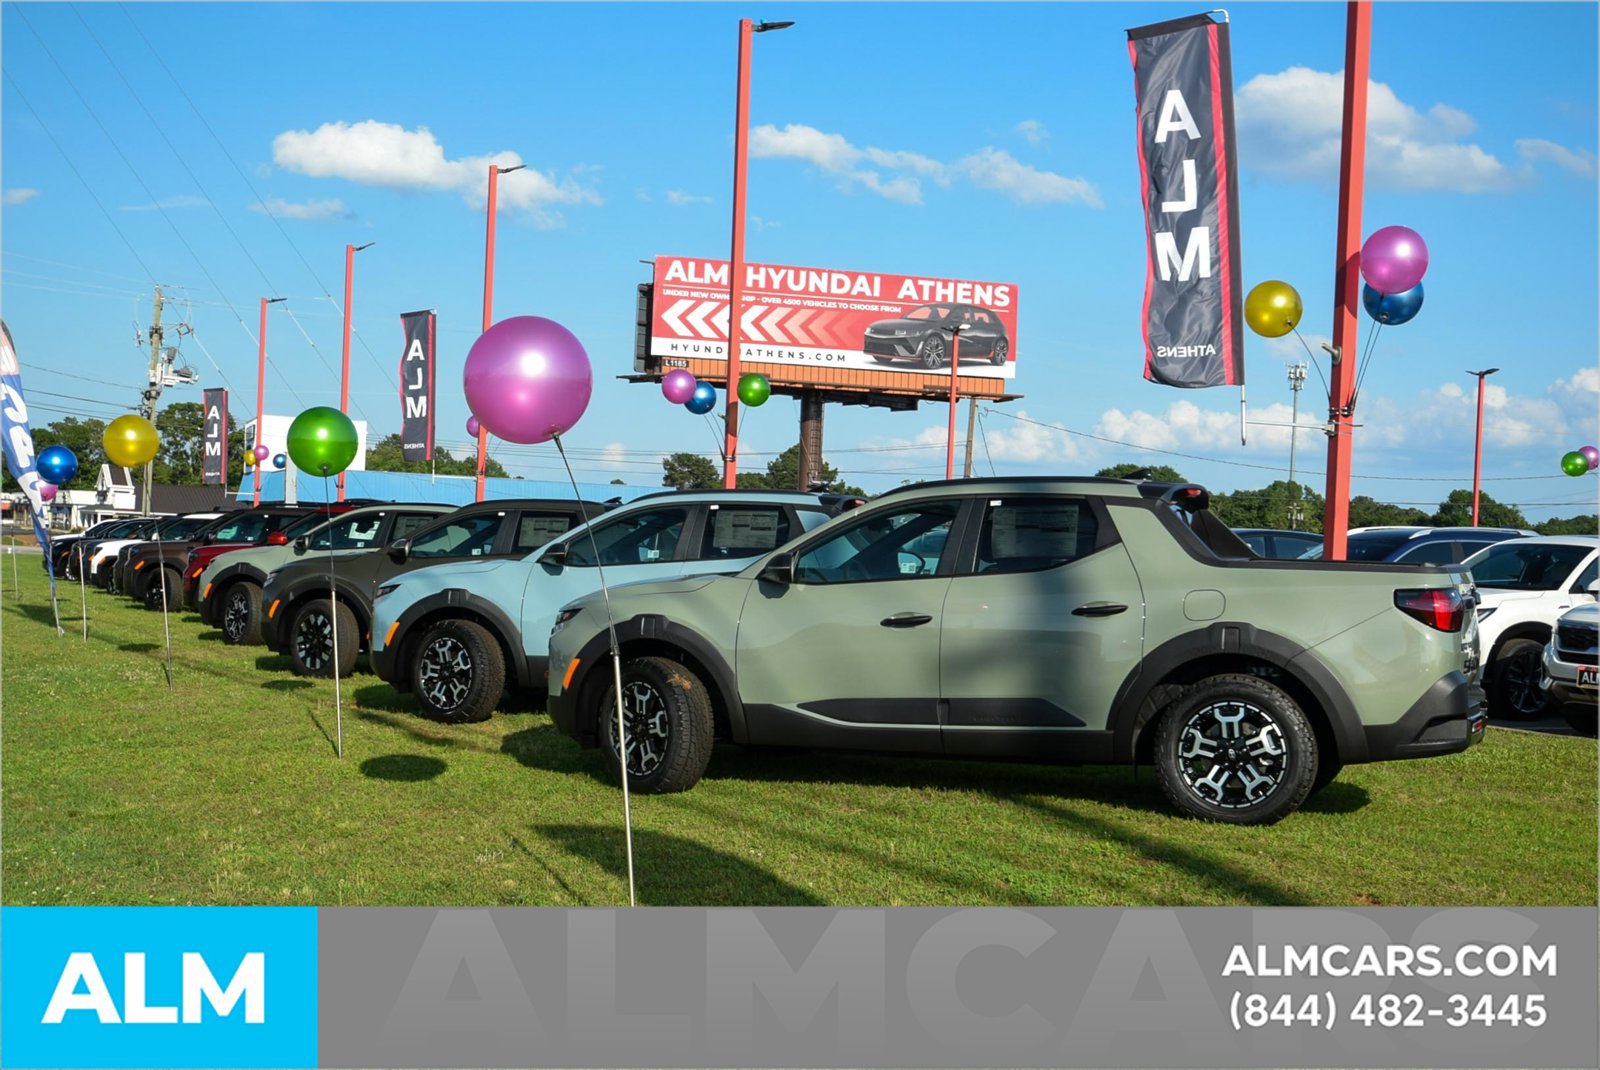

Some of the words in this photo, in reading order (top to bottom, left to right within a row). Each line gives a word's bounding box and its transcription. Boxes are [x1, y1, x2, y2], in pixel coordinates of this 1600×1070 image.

[662, 289, 689, 298] UNDER
[690, 291, 708, 299] NEW
[761, 297, 782, 305] OVER
[802, 300, 838, 309] VEHICLES
[849, 303, 880, 312] CHOOSE
[880, 305, 902, 313] FROM
[665, 260, 728, 285] ALM
[745, 266, 881, 297] HYUNDAI
[897, 279, 1010, 307] ATHENS
